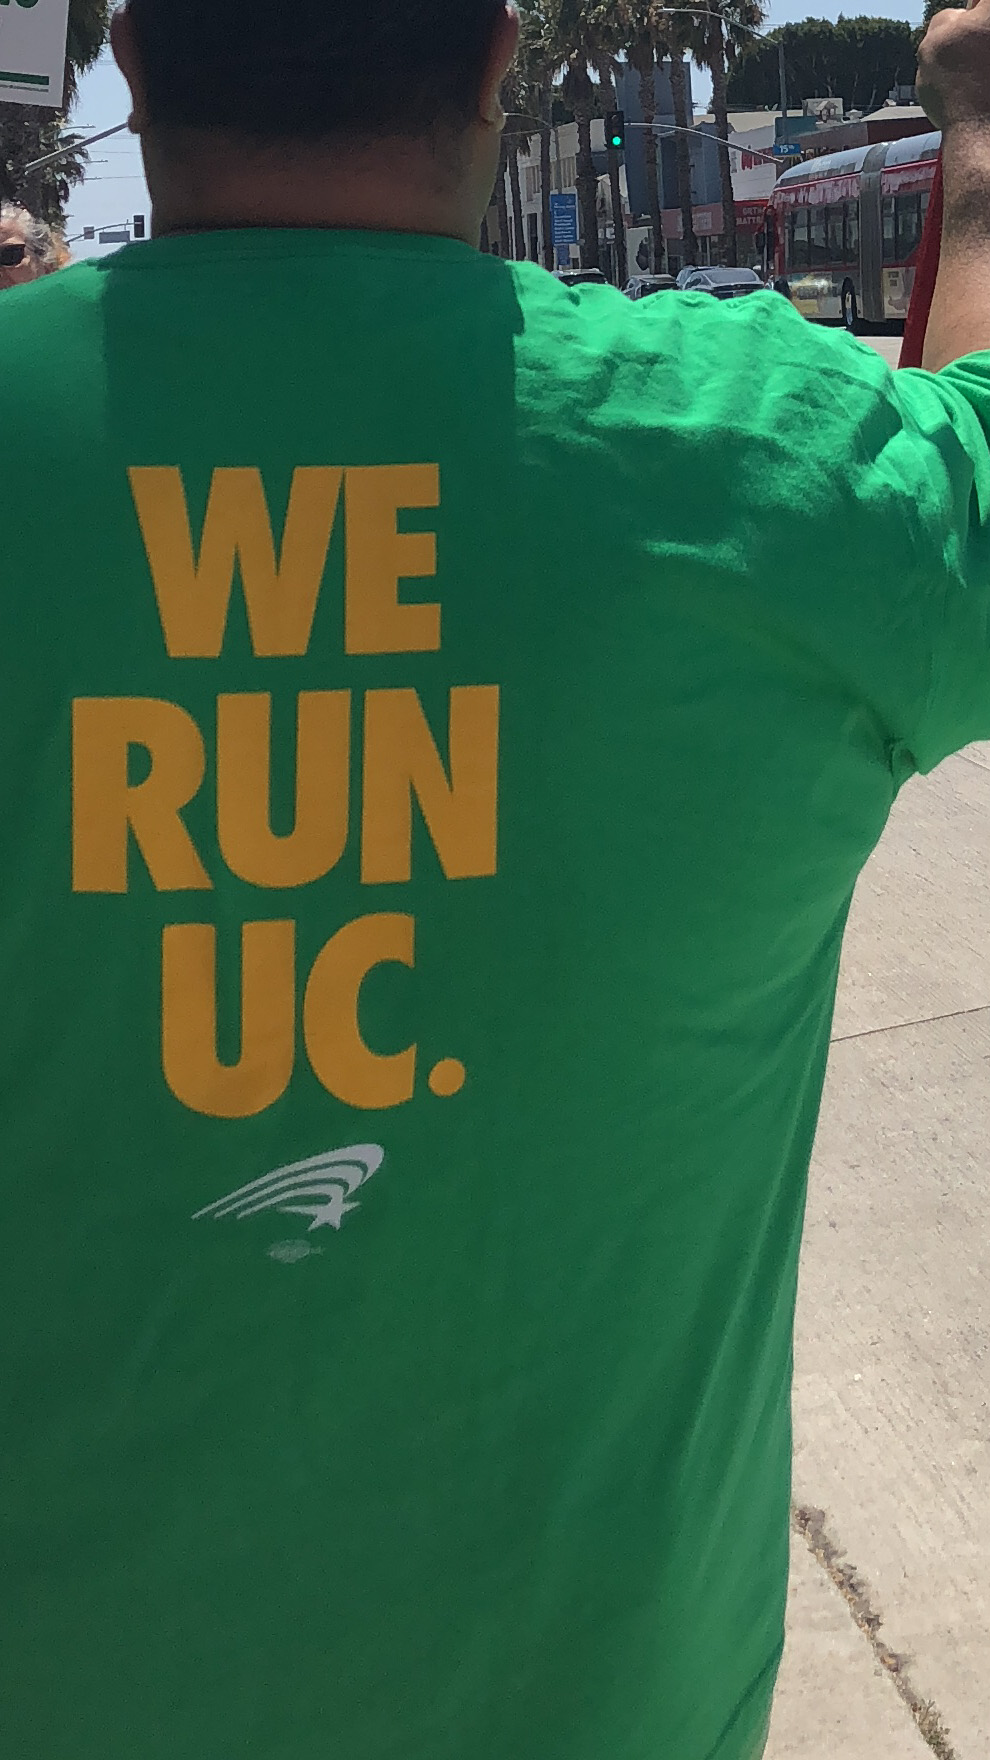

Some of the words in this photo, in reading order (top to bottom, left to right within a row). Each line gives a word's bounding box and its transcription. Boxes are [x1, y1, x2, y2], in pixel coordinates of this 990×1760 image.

[126, 462, 441, 659] WE
[71, 684, 500, 894] RUN
[161, 912, 466, 1120] UC.
